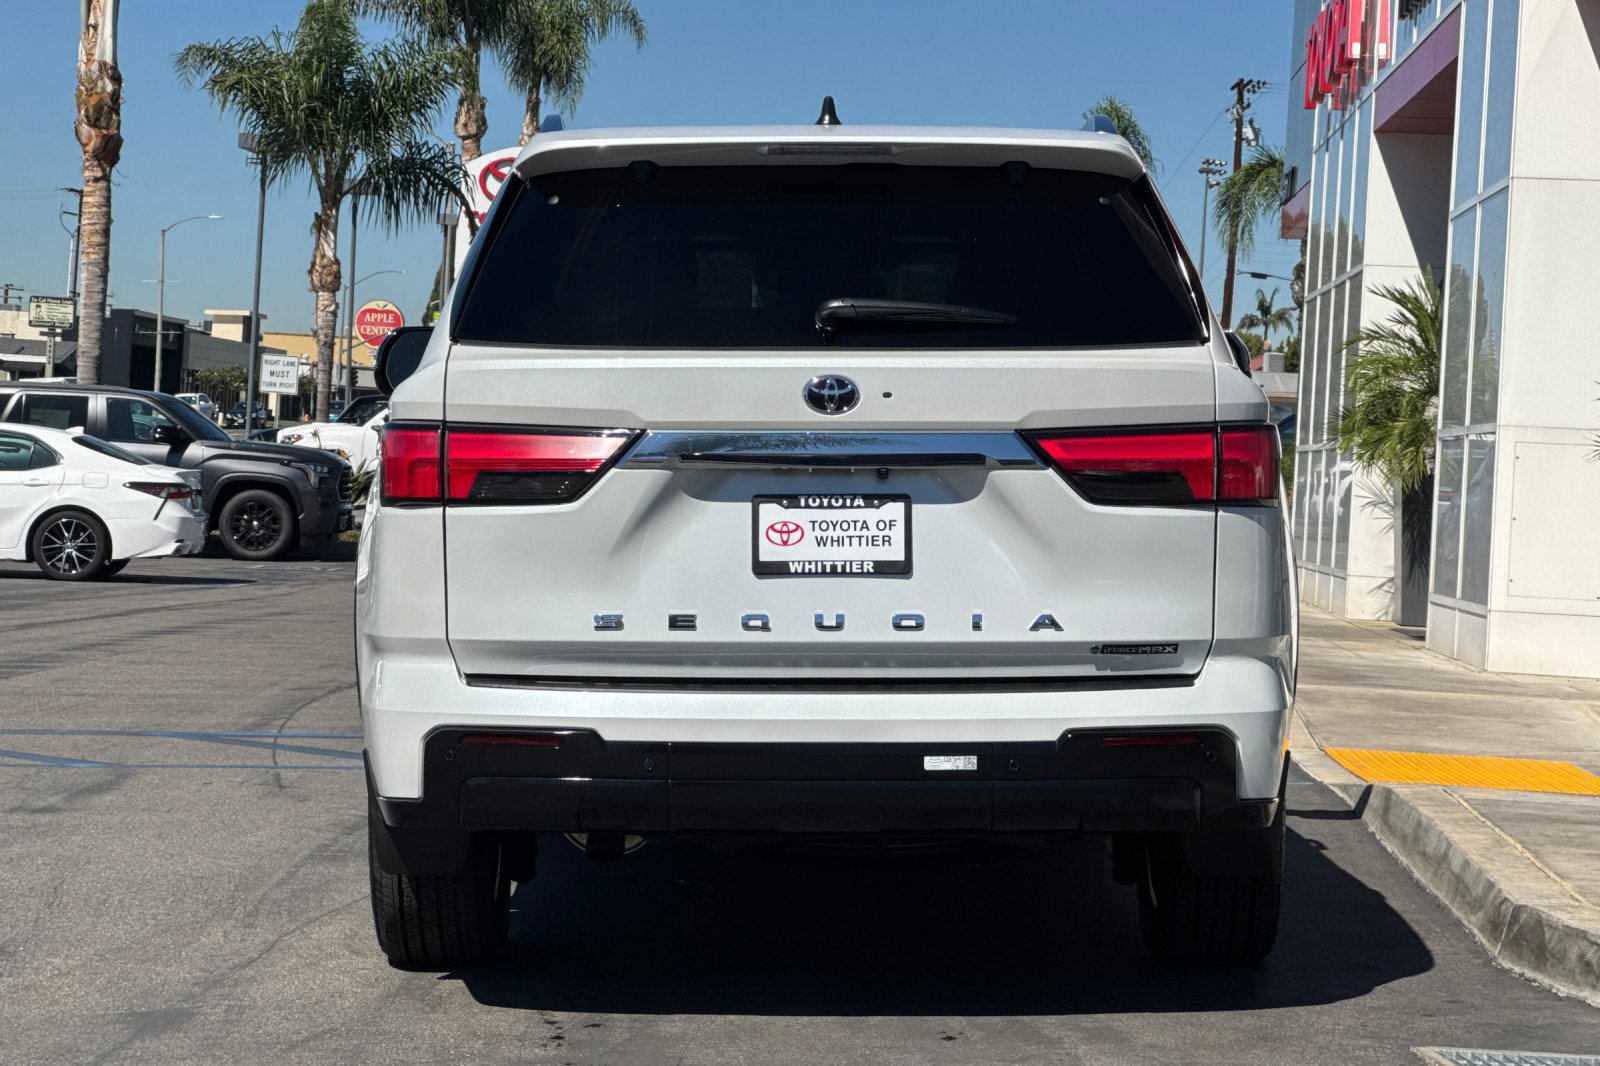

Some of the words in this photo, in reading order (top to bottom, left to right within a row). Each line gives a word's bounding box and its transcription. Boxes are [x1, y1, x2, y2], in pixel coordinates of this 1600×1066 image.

[364, 312, 395, 323] APPLE
[264, 359, 281, 367] RIGHT
[282, 360, 297, 368] LANE
[270, 370, 290, 378] MUST
[798, 495, 865, 507] TOYOTA
[808, 520, 870, 532] TOYOTA
[876, 519, 897, 532] OF
[815, 535, 892, 547] WHITTIER
[788, 561, 874, 573] WHITTIER
[593, 613, 1065, 632] SEQUOIA
